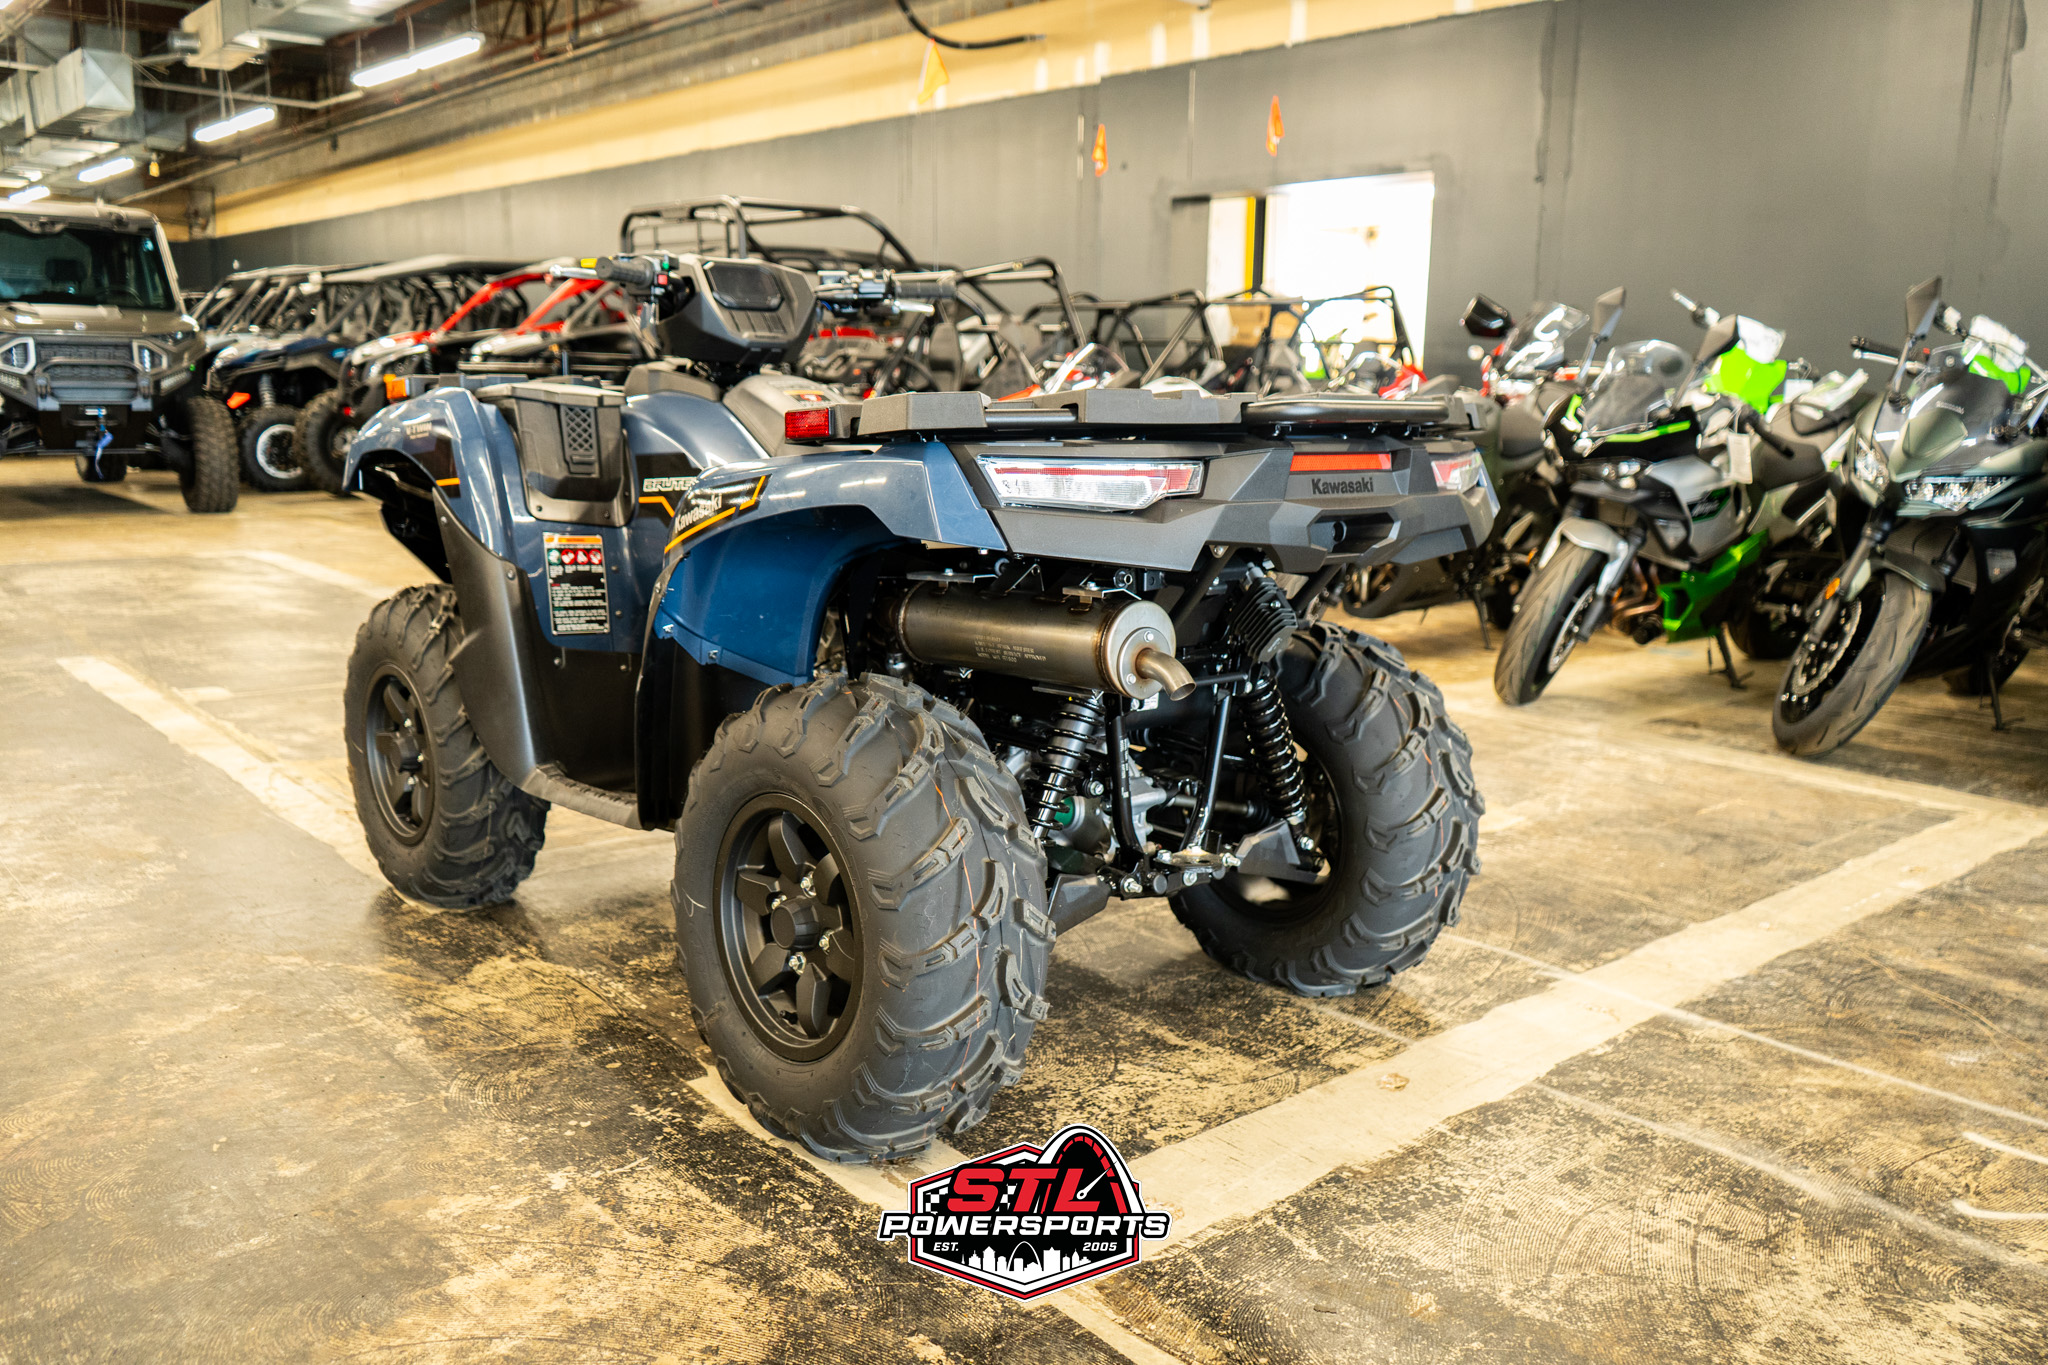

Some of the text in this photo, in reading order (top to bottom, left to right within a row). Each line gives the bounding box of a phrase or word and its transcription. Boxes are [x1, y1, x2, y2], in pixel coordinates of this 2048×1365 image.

[643, 477, 698, 492] BRUTE
[1311, 477, 1374, 495] Kawasaki
[674, 492, 723, 534] Kawasaki
